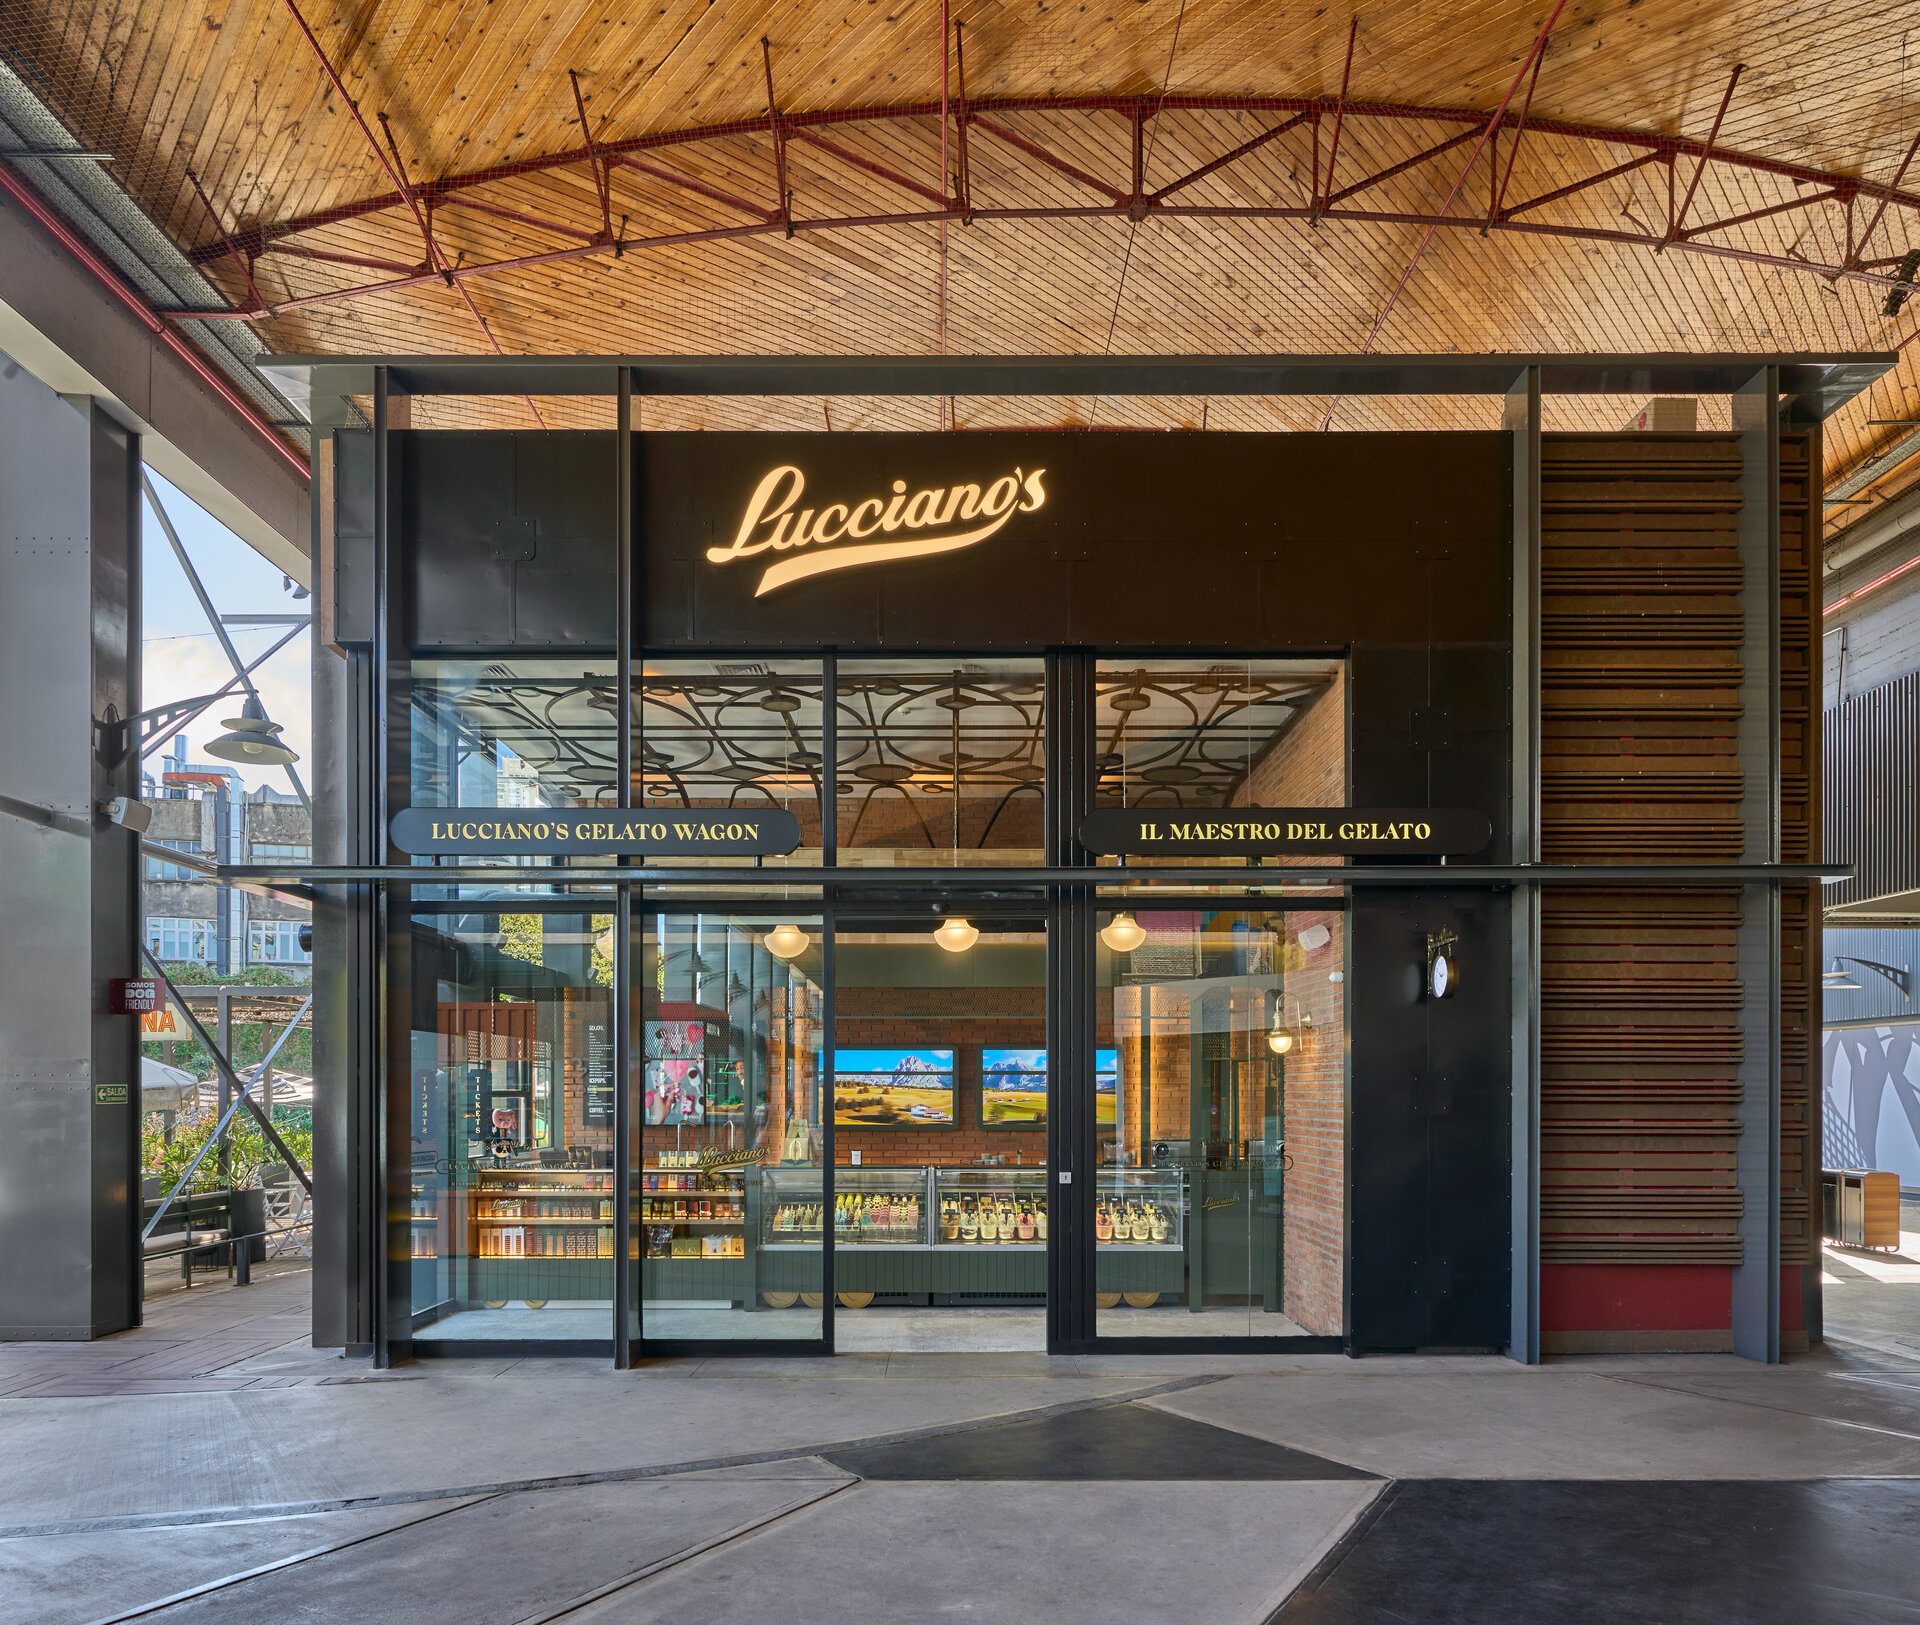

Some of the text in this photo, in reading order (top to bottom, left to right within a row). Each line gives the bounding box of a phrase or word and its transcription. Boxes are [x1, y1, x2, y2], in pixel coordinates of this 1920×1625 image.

[707, 466, 1046, 598] Lucciano's
[432, 822, 759, 840] LUCCIANO'S GELATO WAGON
[1141, 823, 1431, 840] IL MAESTRO DEL GELATO
[125, 989, 155, 998] DOG
[125, 1000, 155, 1010] FRIENDLY
[106, 1087, 126, 1096] SALIDA
